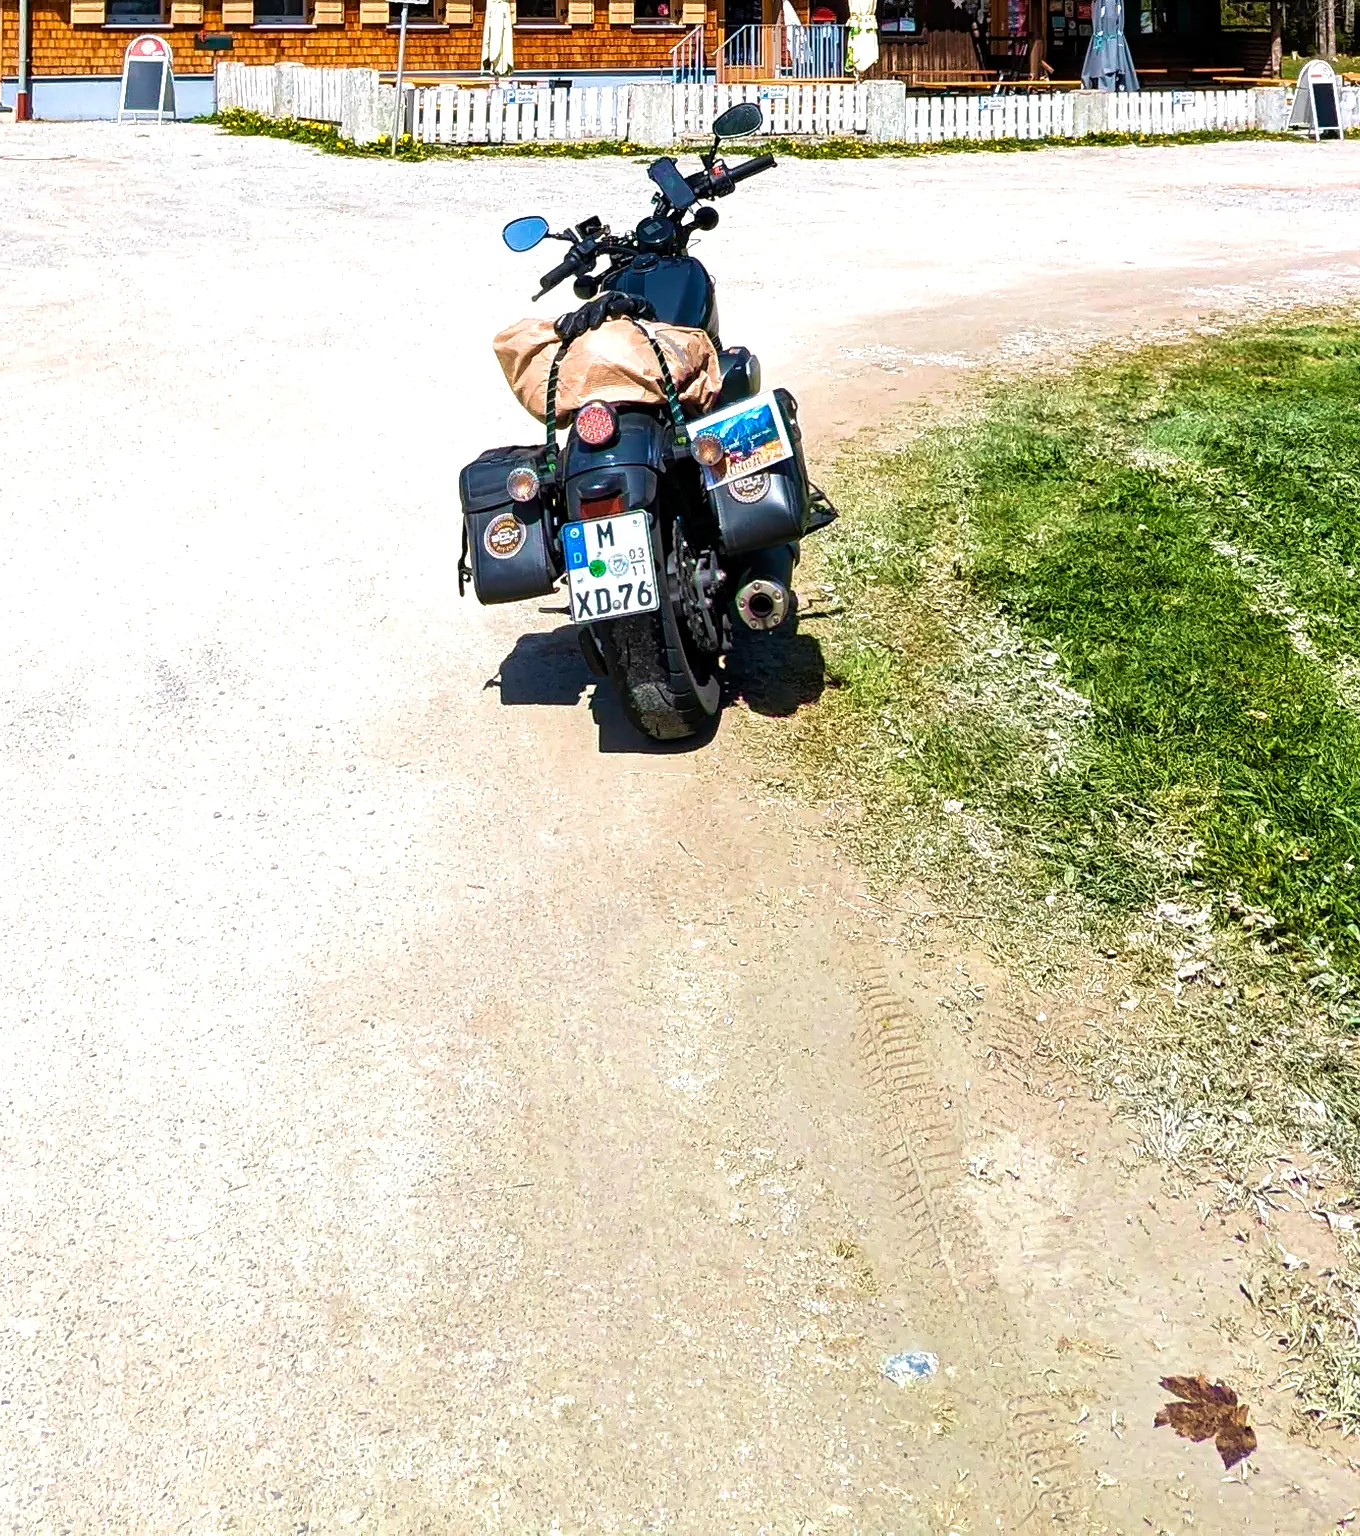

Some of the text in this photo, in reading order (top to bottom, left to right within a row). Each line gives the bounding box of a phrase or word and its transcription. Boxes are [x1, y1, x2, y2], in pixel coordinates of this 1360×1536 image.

[734, 473, 763, 489] BOLT
[596, 521, 615, 548] M
[573, 552, 582, 564] D
[628, 547, 645, 560] 03
[632, 564, 646, 576] 11
[618, 580, 652, 610] 76
